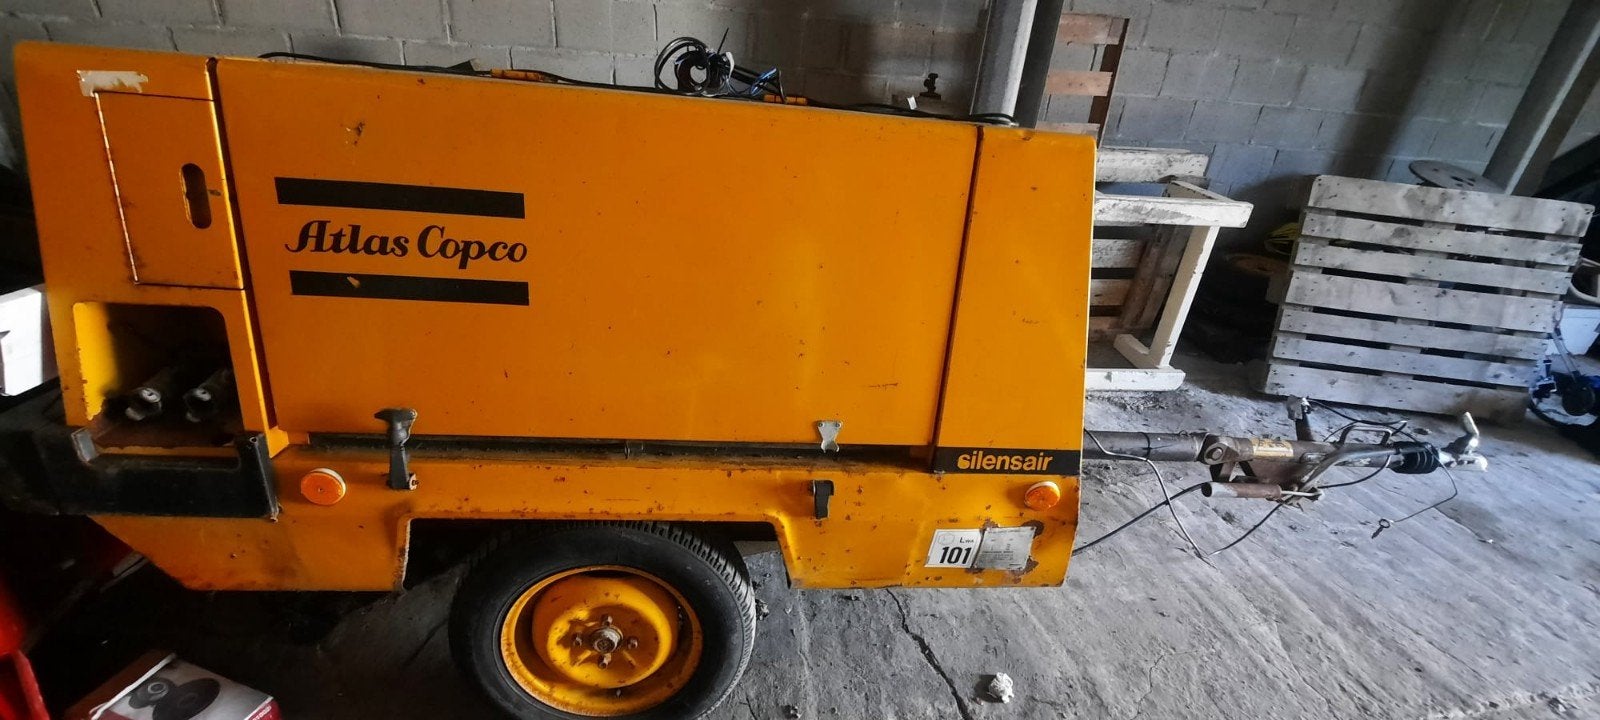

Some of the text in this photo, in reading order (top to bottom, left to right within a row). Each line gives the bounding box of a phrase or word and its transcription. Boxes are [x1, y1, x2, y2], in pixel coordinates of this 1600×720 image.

[284, 220, 528, 270] Atlas Copco
[956, 450, 1054, 471] silensair
[939, 546, 972, 565] 101
